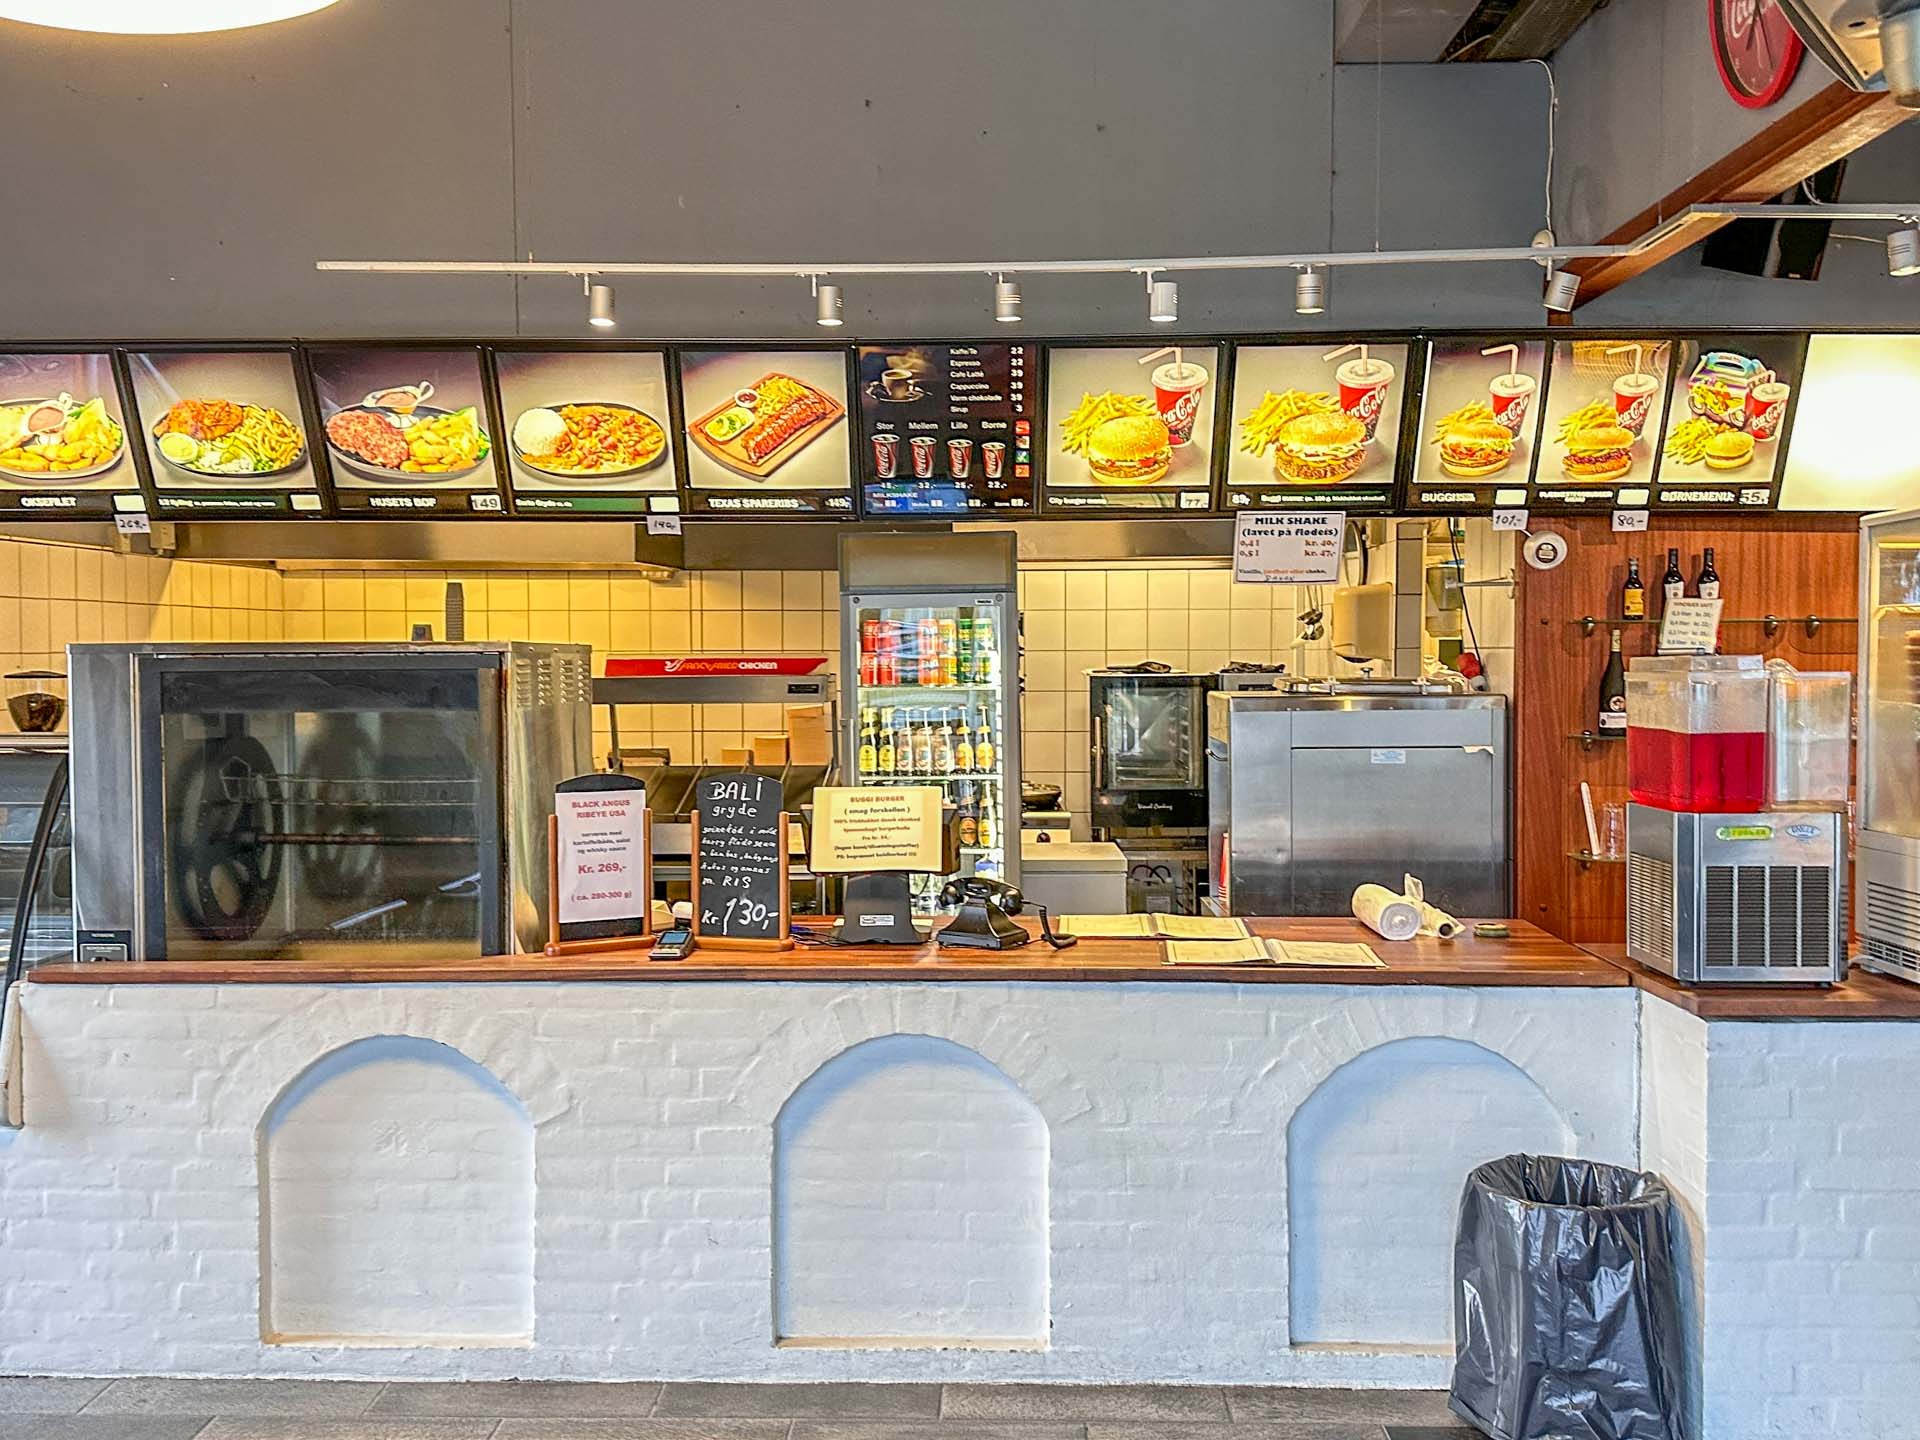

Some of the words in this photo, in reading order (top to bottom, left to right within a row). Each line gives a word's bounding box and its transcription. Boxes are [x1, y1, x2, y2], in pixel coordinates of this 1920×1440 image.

[876, 421, 895, 430] Stor
[908, 421, 939, 430] Mellem
[369, 496, 413, 508] HUSETS
[708, 497, 741, 509] TEXAS
[741, 497, 800, 509] SPARERIBS
[1255, 517, 1284, 525] MILK
[1287, 517, 1328, 525] SHAKE
[707, 777, 764, 802] BALI
[572, 800, 600, 809] BLACK
[602, 799, 630, 807] ANGUS
[875, 795, 905, 803] BURGER
[576, 810, 608, 819] RIBEYE
[609, 809, 626, 818] USA
[712, 803, 758, 819] gryde
[578, 864, 595, 874] Kr.
[597, 862, 627, 873] 269,-
[722, 875, 752, 889] RIS
[701, 909, 721, 926] Kr.
[723, 898, 779, 936] 130,-
